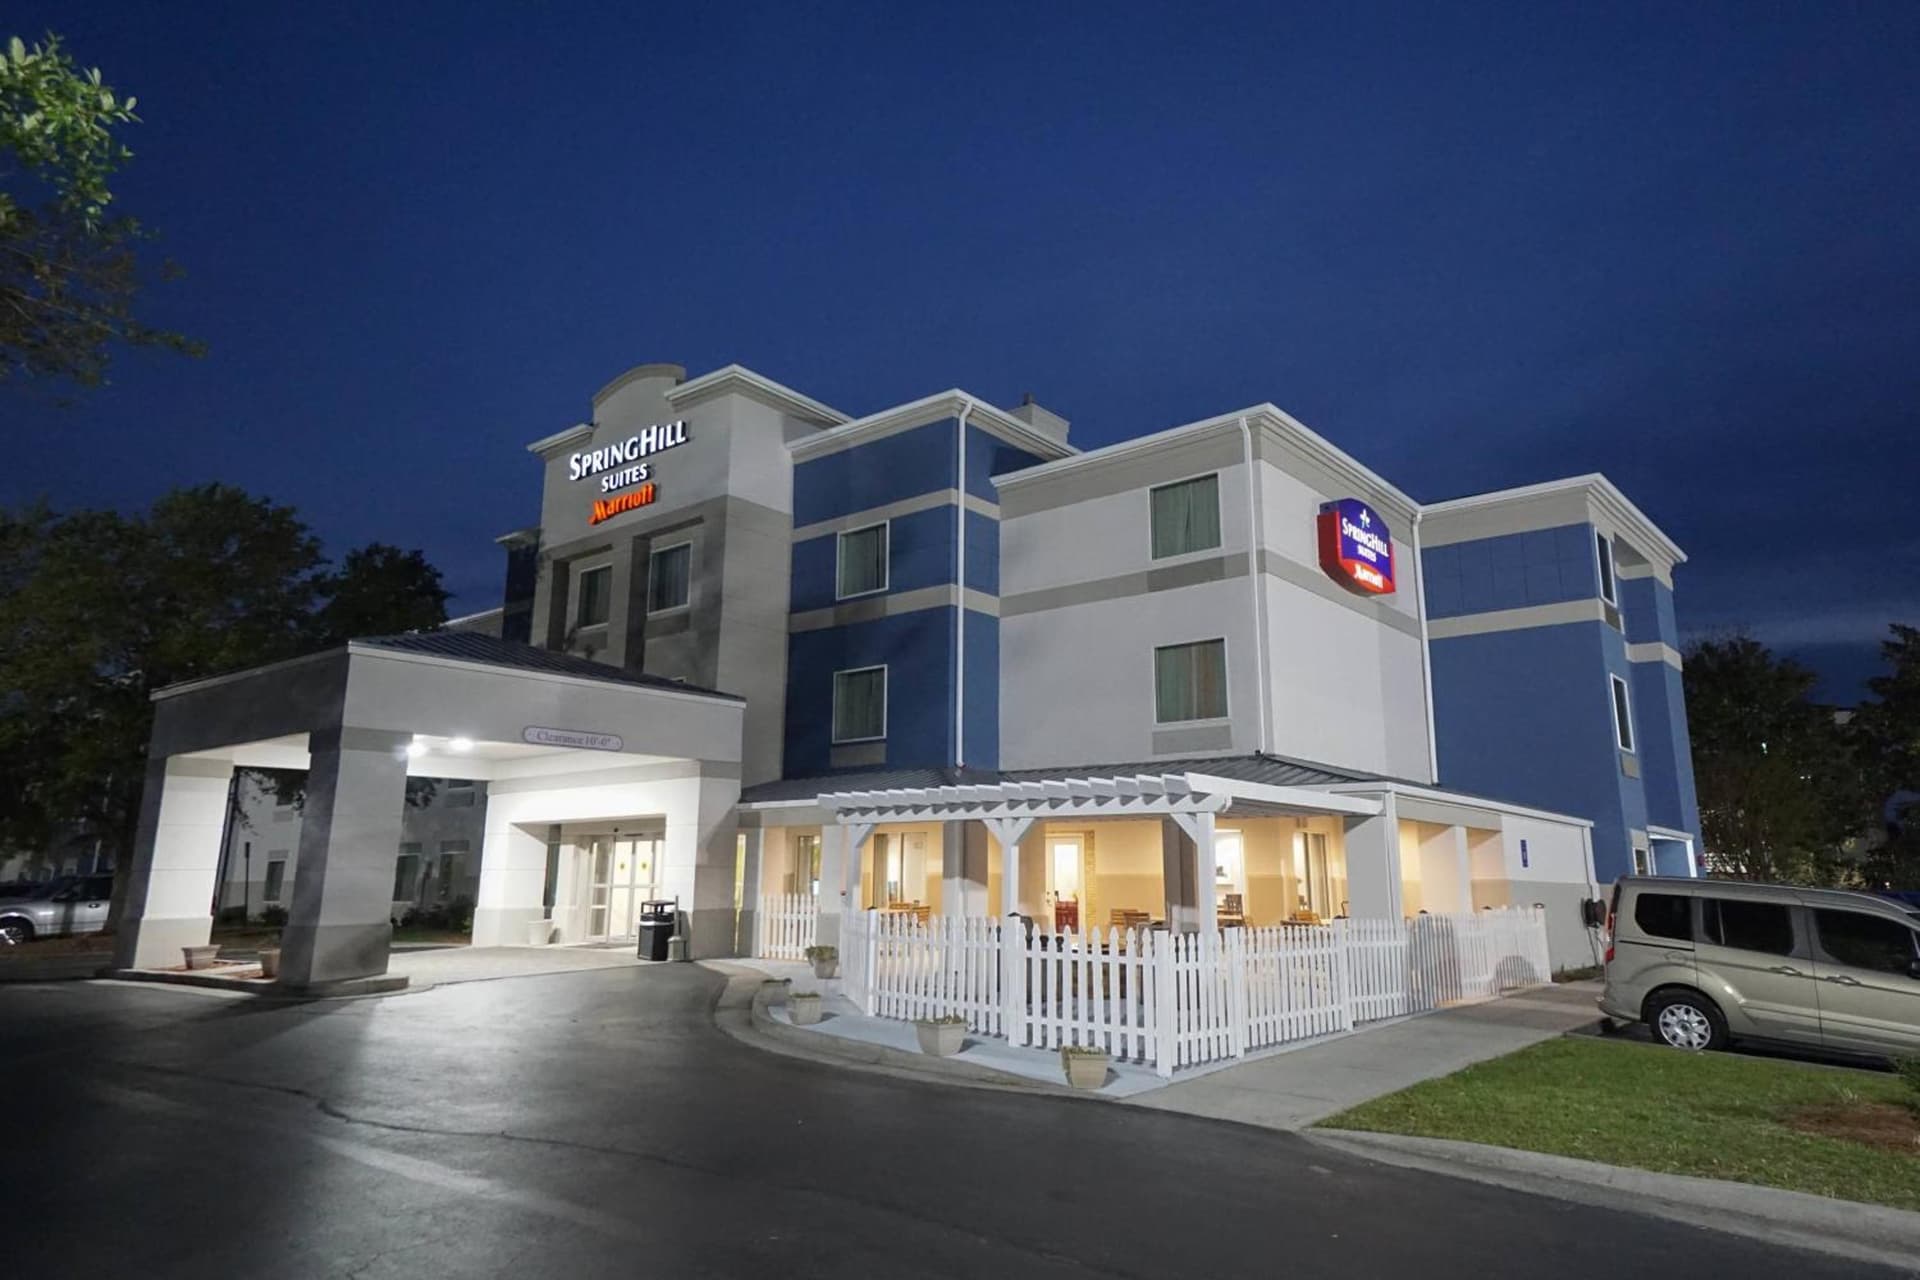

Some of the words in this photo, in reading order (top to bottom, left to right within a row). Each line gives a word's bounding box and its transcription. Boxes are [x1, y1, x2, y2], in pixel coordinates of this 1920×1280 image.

[569, 420, 686, 481] SPRINGHILL
[601, 463, 649, 493] SUITES
[587, 482, 655, 527] Marriott
[1342, 517, 1390, 557] SPRINGHILL
